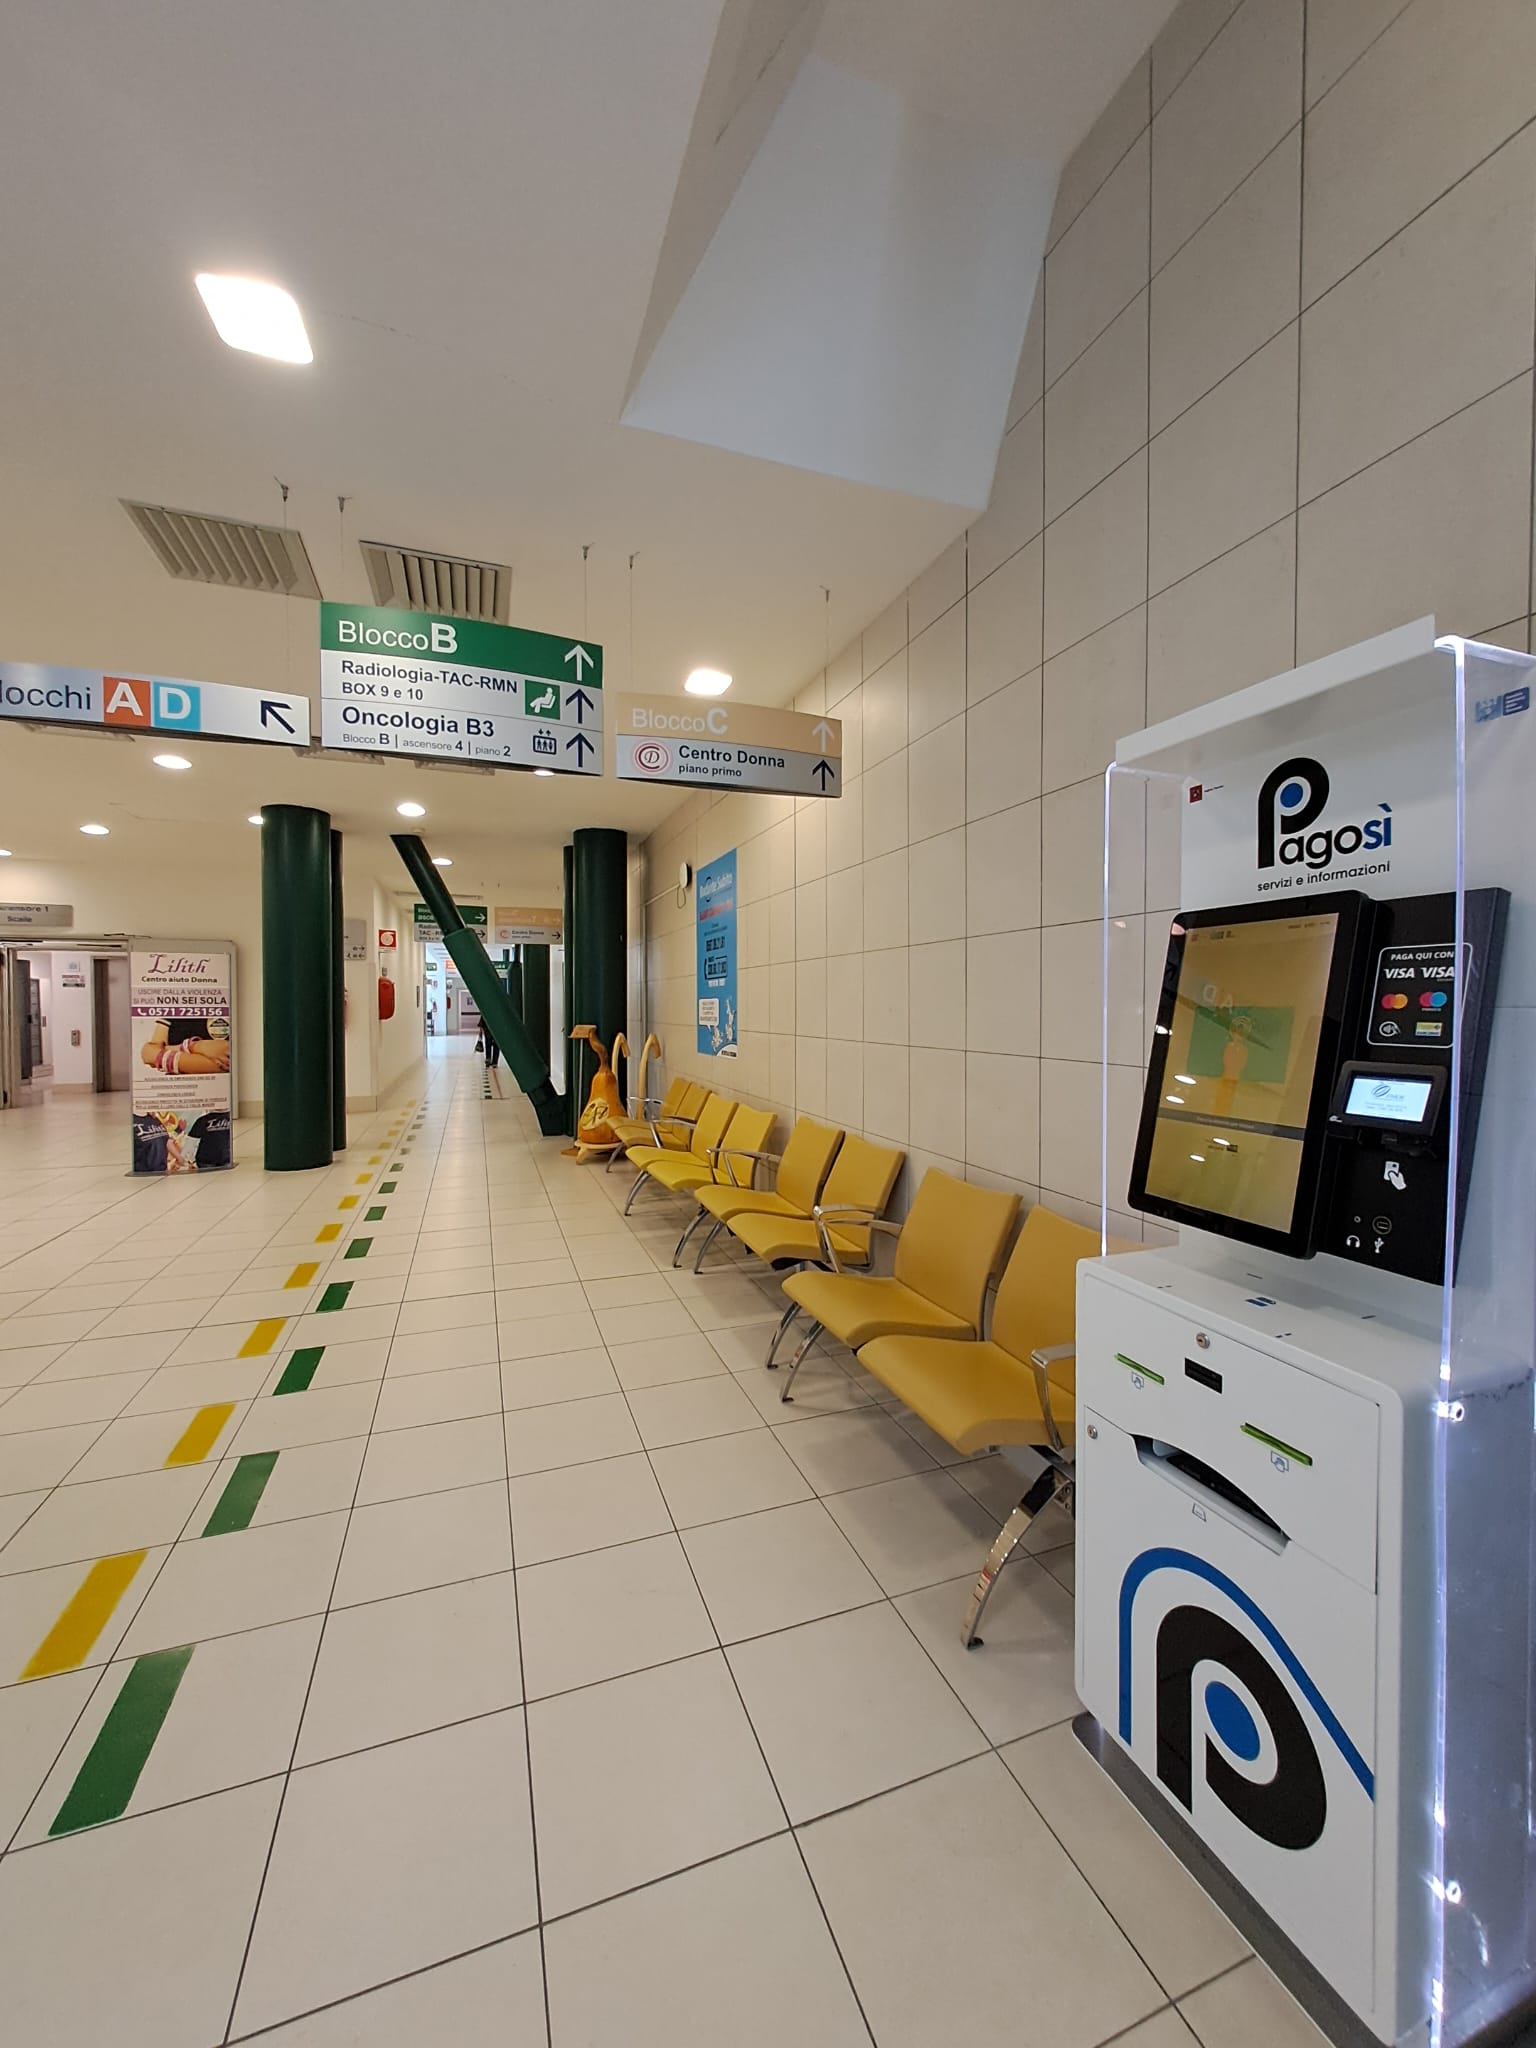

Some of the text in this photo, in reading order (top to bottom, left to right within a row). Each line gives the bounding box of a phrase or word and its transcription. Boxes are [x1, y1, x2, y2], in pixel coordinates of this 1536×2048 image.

[341, 660, 518, 694] Radiologia-TAC-RMN
[106, 681, 144, 716] A
[159, 688, 191, 721] D
[342, 682, 424, 701] BOX 9 e 10
[342, 706, 495, 738] Oncologia B3
[343, 733, 511, 757] Blocco B ascensore 4 piano 2
[678, 745, 785, 768] Centro Donna
[678, 764, 742, 777] piano primo
[1257, 757, 1393, 870] Pagosì
[1257, 860, 1391, 892] servizi e informazioni
[147, 953, 211, 974] Lilith
[1390, 951, 1455, 961] PAGA QUI CON
[1384, 966, 1455, 979] VISA VISA
[156, 996, 179, 1005] NON
[181, 997, 197, 1005] SEI
[199, 997, 227, 1005] SOLA
[163, 988, 186, 996] DALLA
[148, 1008, 223, 1016] 0571 725156
